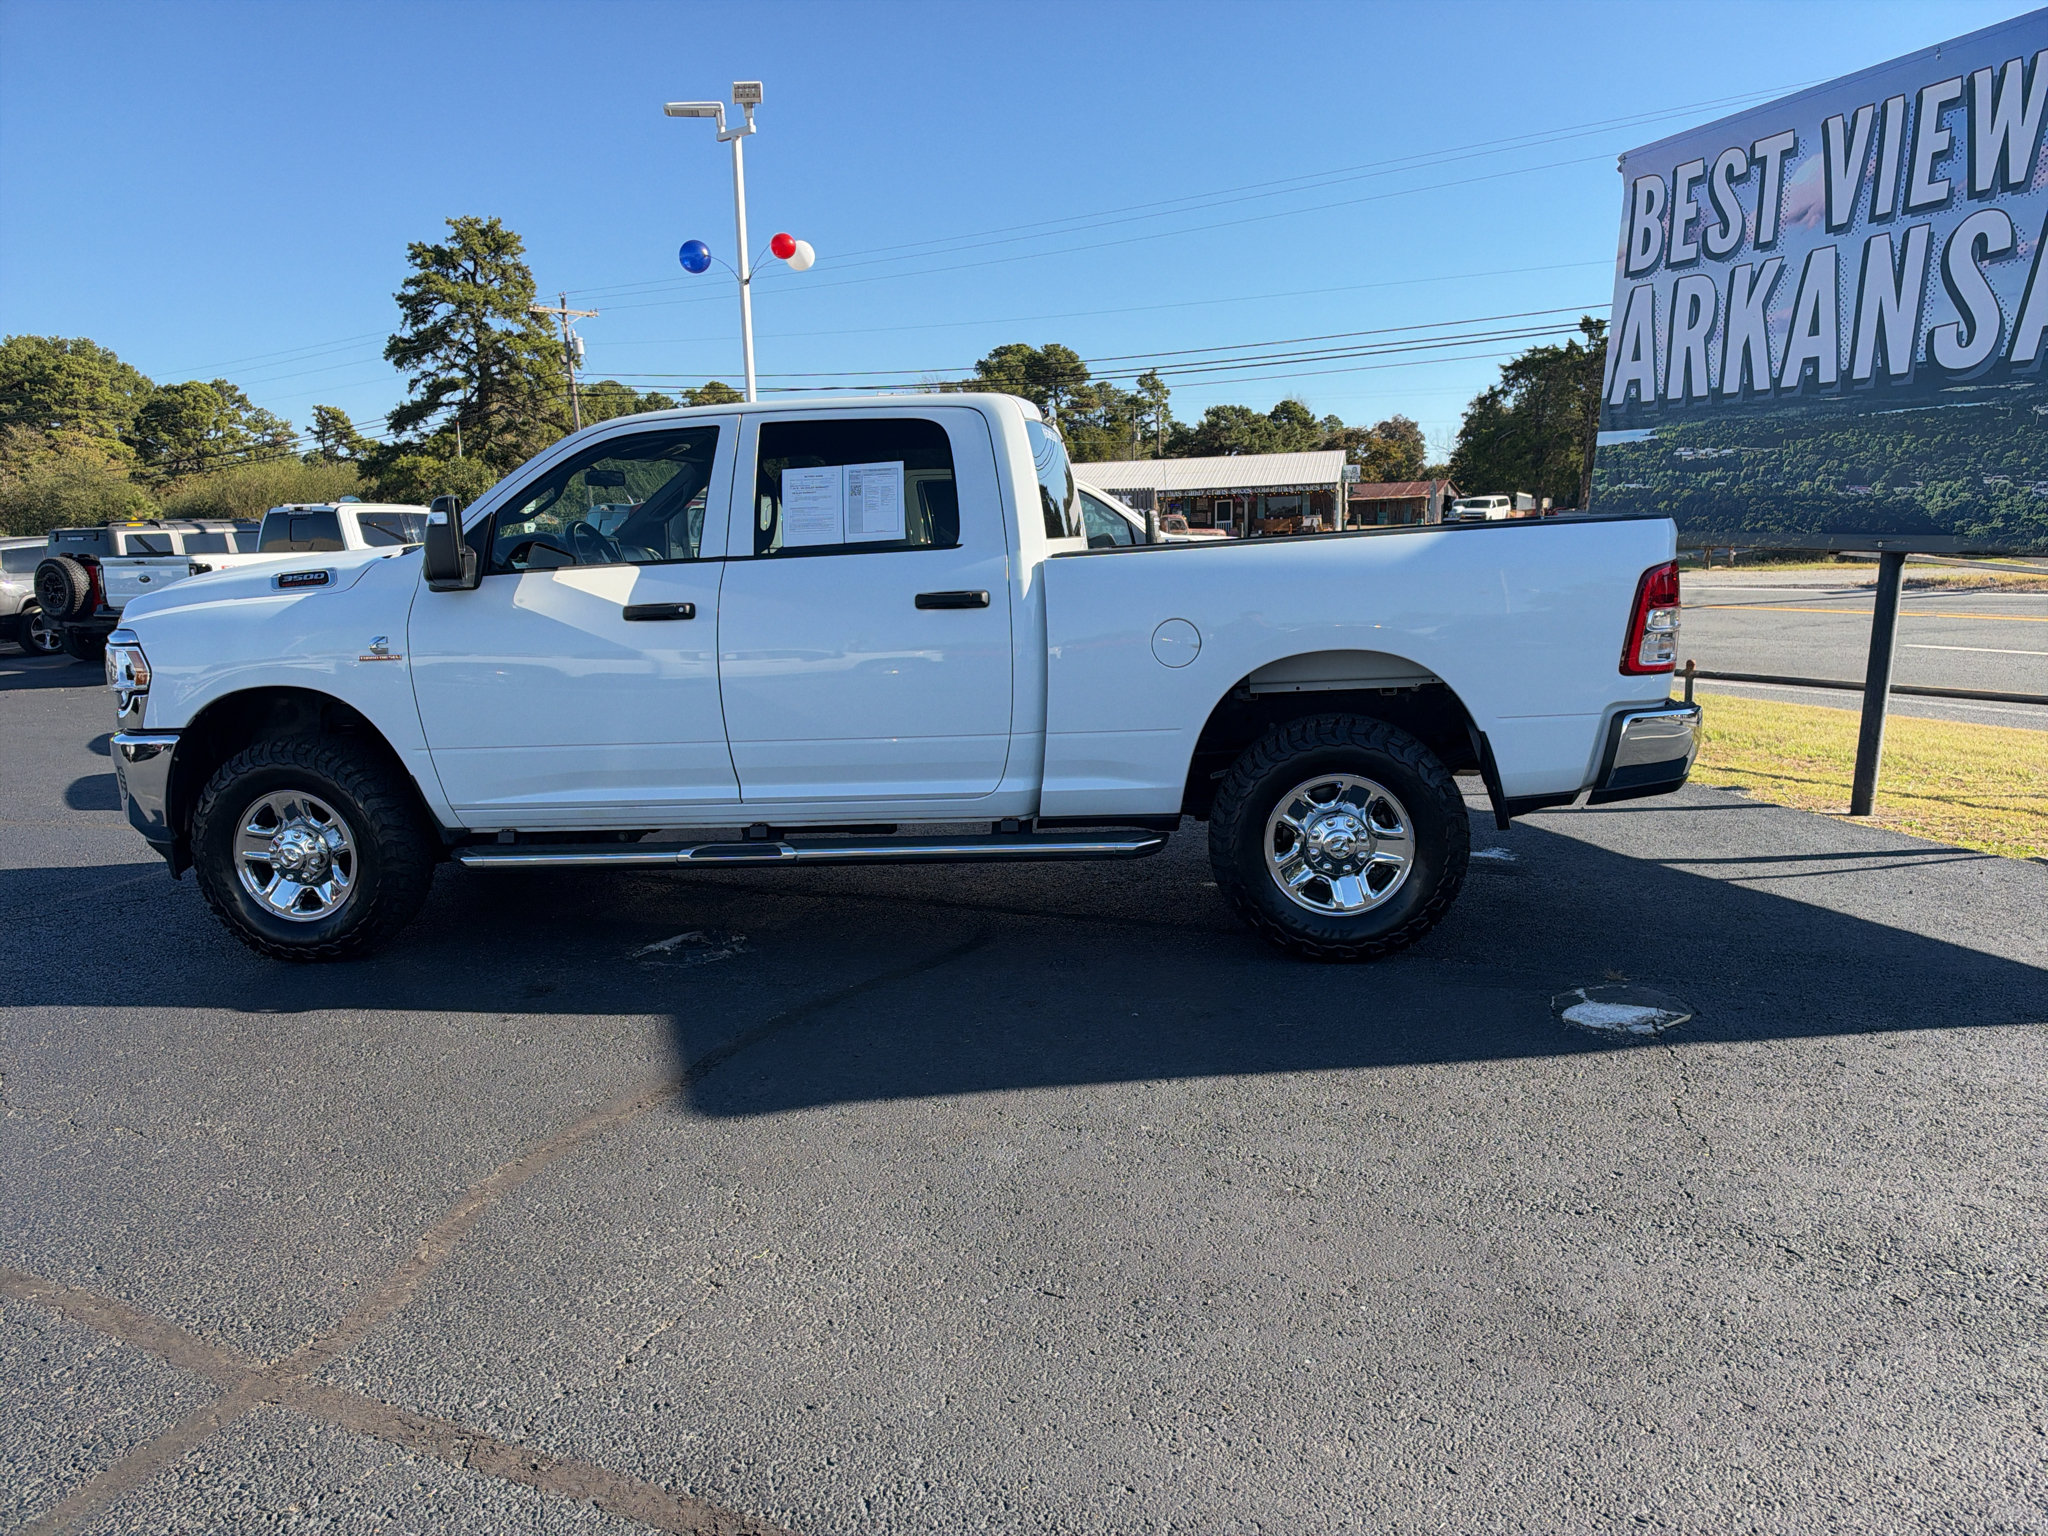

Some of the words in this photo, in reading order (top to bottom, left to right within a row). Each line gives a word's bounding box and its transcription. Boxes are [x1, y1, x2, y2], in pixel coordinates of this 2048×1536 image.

[1624, 128, 1799, 280] BEST
[1820, 48, 2048, 234] VIEW
[281, 572, 326, 583] 3500
